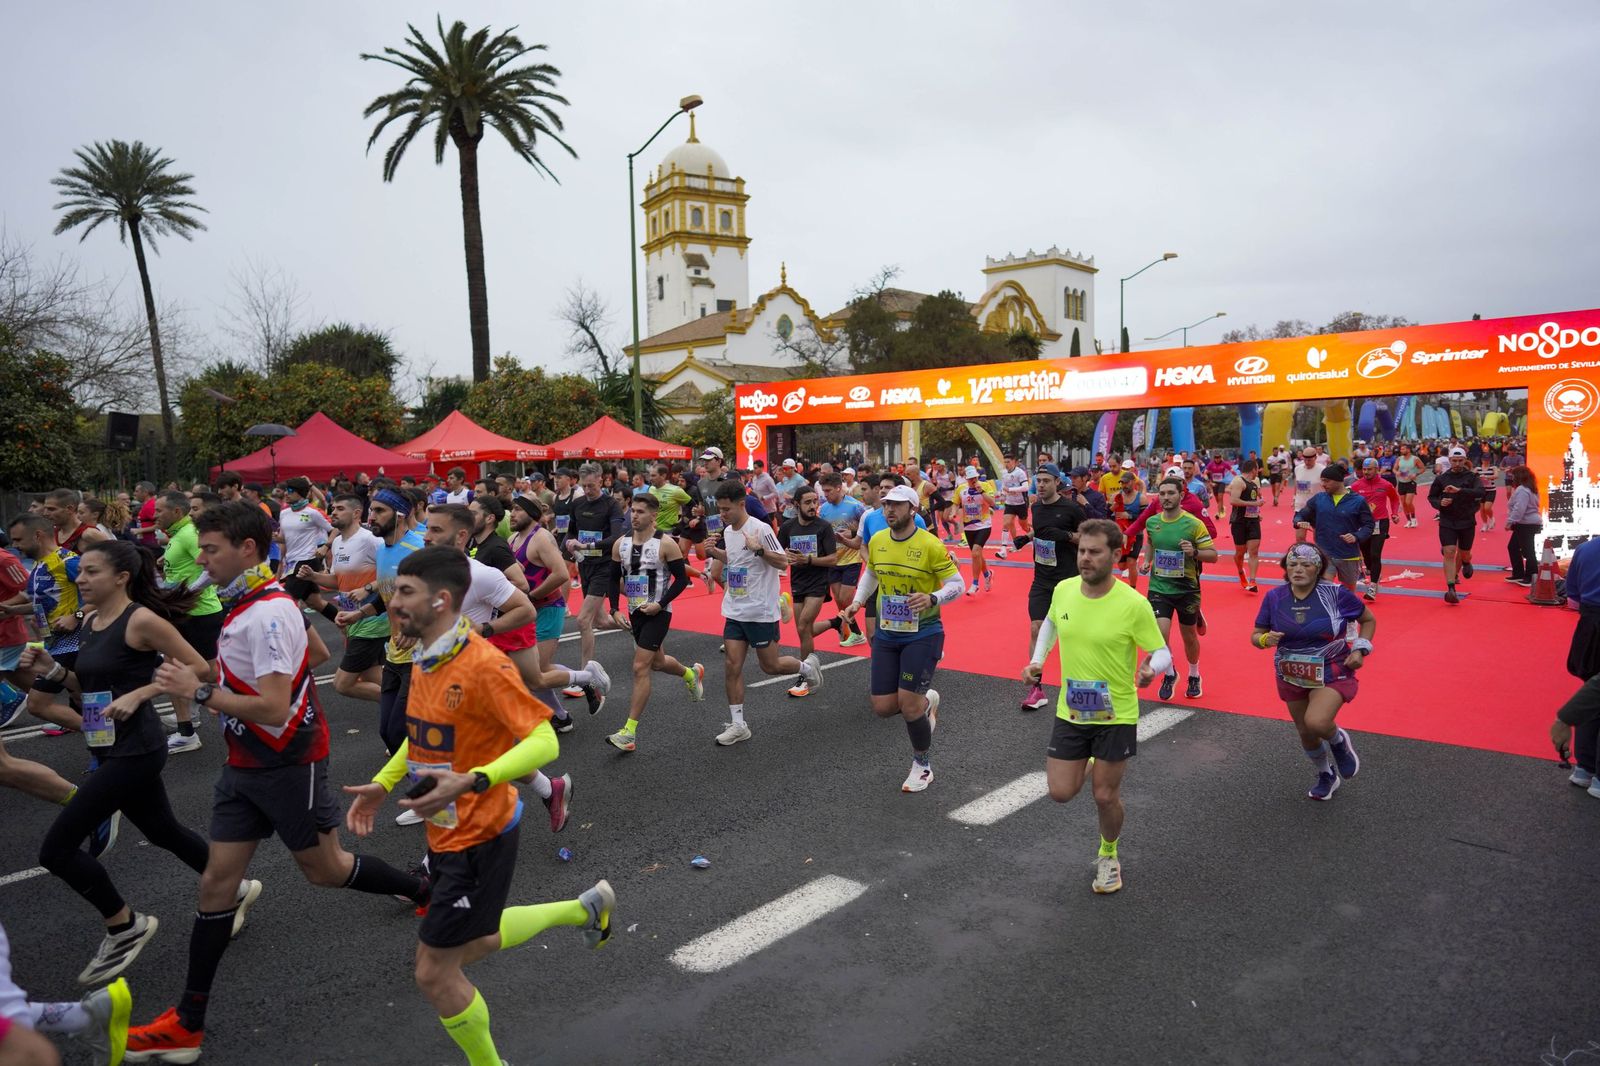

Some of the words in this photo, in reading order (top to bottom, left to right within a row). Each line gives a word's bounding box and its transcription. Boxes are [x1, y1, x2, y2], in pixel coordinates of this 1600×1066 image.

[1411, 348, 1489, 365] Sprinter
[987, 370, 1060, 389] maratón
[1154, 365, 1216, 387] HOKA
[1227, 374, 1276, 386] HYUNDAI
[880, 387, 923, 405] HOKA
[886, 604, 910, 617] 3235
[1285, 662, 1312, 677] 1331
[1071, 690, 1098, 705] 2977
